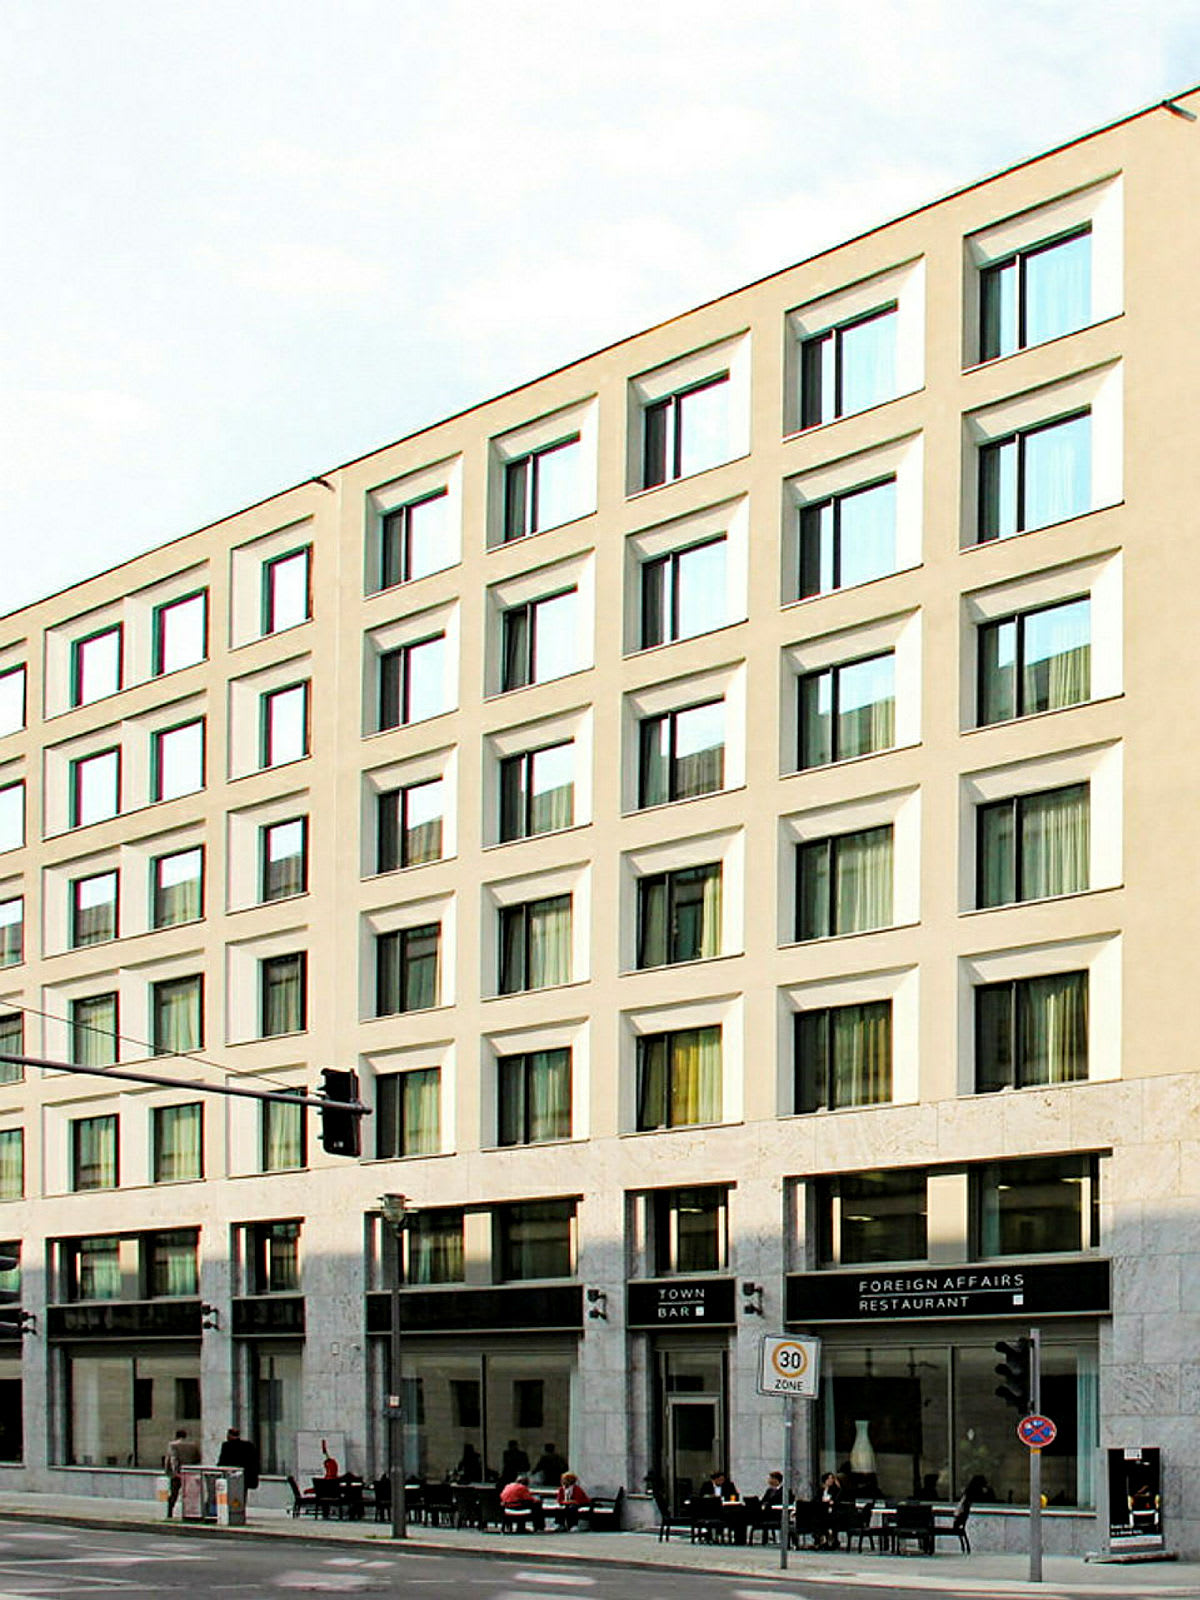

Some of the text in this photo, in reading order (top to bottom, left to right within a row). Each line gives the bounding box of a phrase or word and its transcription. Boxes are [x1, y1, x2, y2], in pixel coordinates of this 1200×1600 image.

[859, 1273, 1024, 1292] FOREIGN AFFAIRS
[658, 1289, 705, 1300] TOWN
[859, 1296, 969, 1312] RESTAURANT
[657, 1306, 690, 1318] BAR
[779, 1351, 801, 1369] 30
[774, 1379, 804, 1391] ZONE
